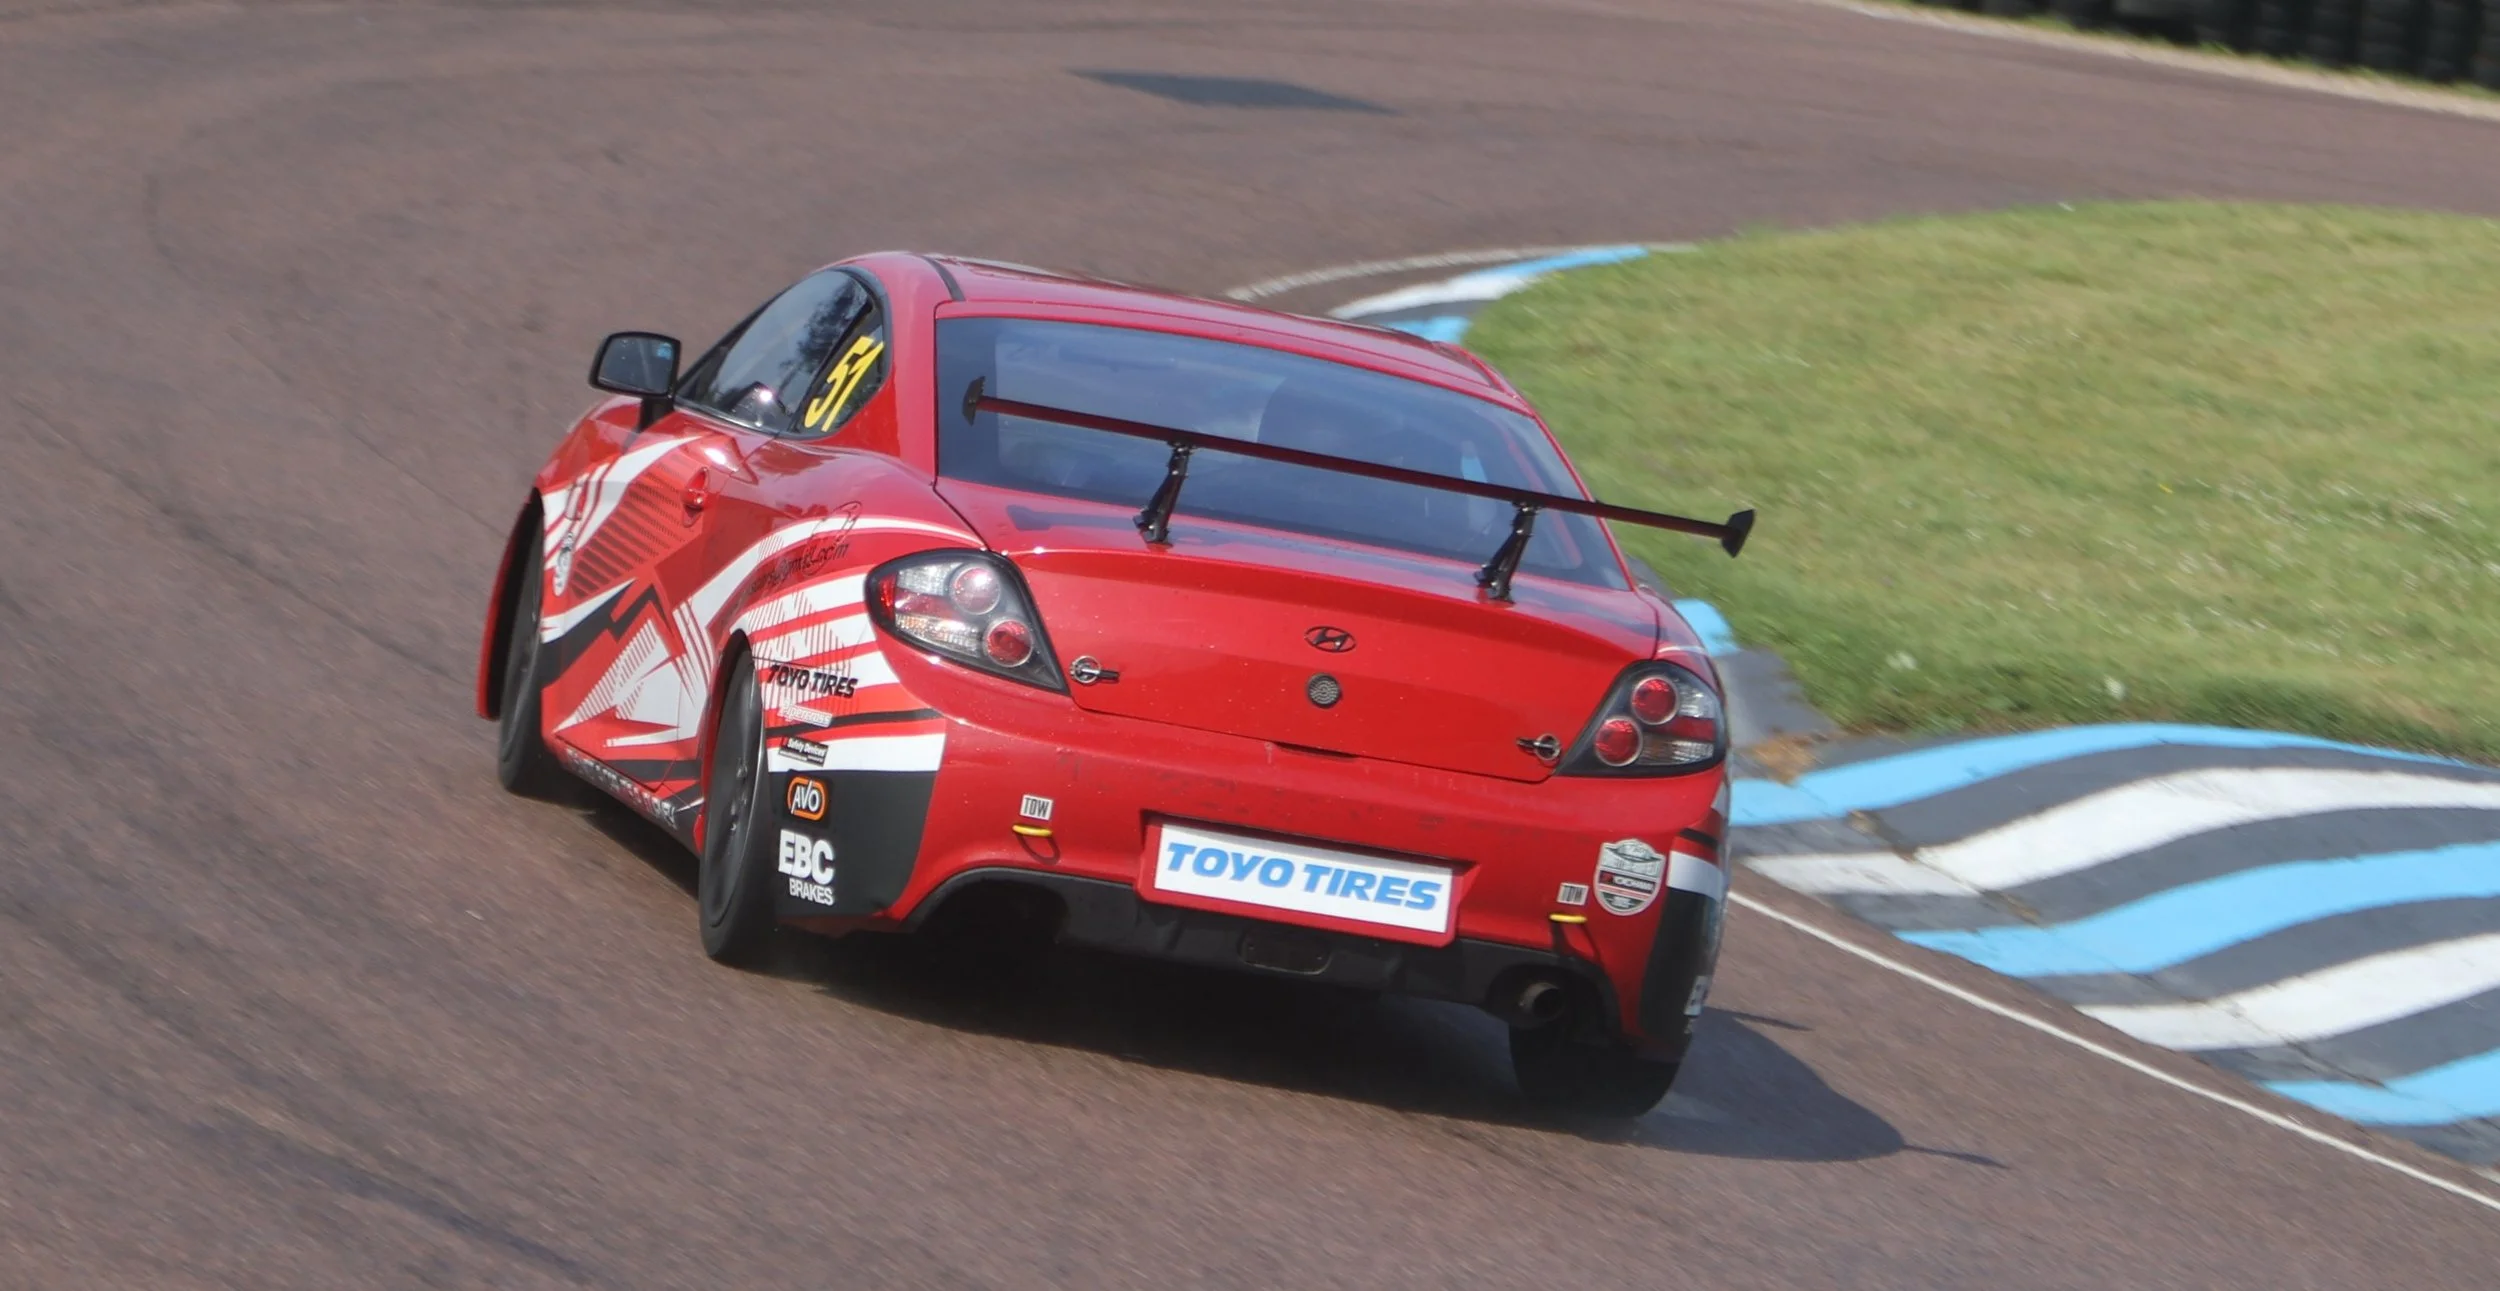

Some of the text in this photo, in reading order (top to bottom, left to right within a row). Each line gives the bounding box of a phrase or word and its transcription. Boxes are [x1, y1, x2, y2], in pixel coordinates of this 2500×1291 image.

[804, 335, 884, 432] 51
[766, 664, 858, 698] TOYO TIRES
[790, 780, 820, 814] AVO
[1023, 797, 1050, 818] TOW
[778, 828, 835, 885] EBC
[789, 877, 834, 906] BRAKES
[1167, 842, 1443, 911] TOYO TIRES
